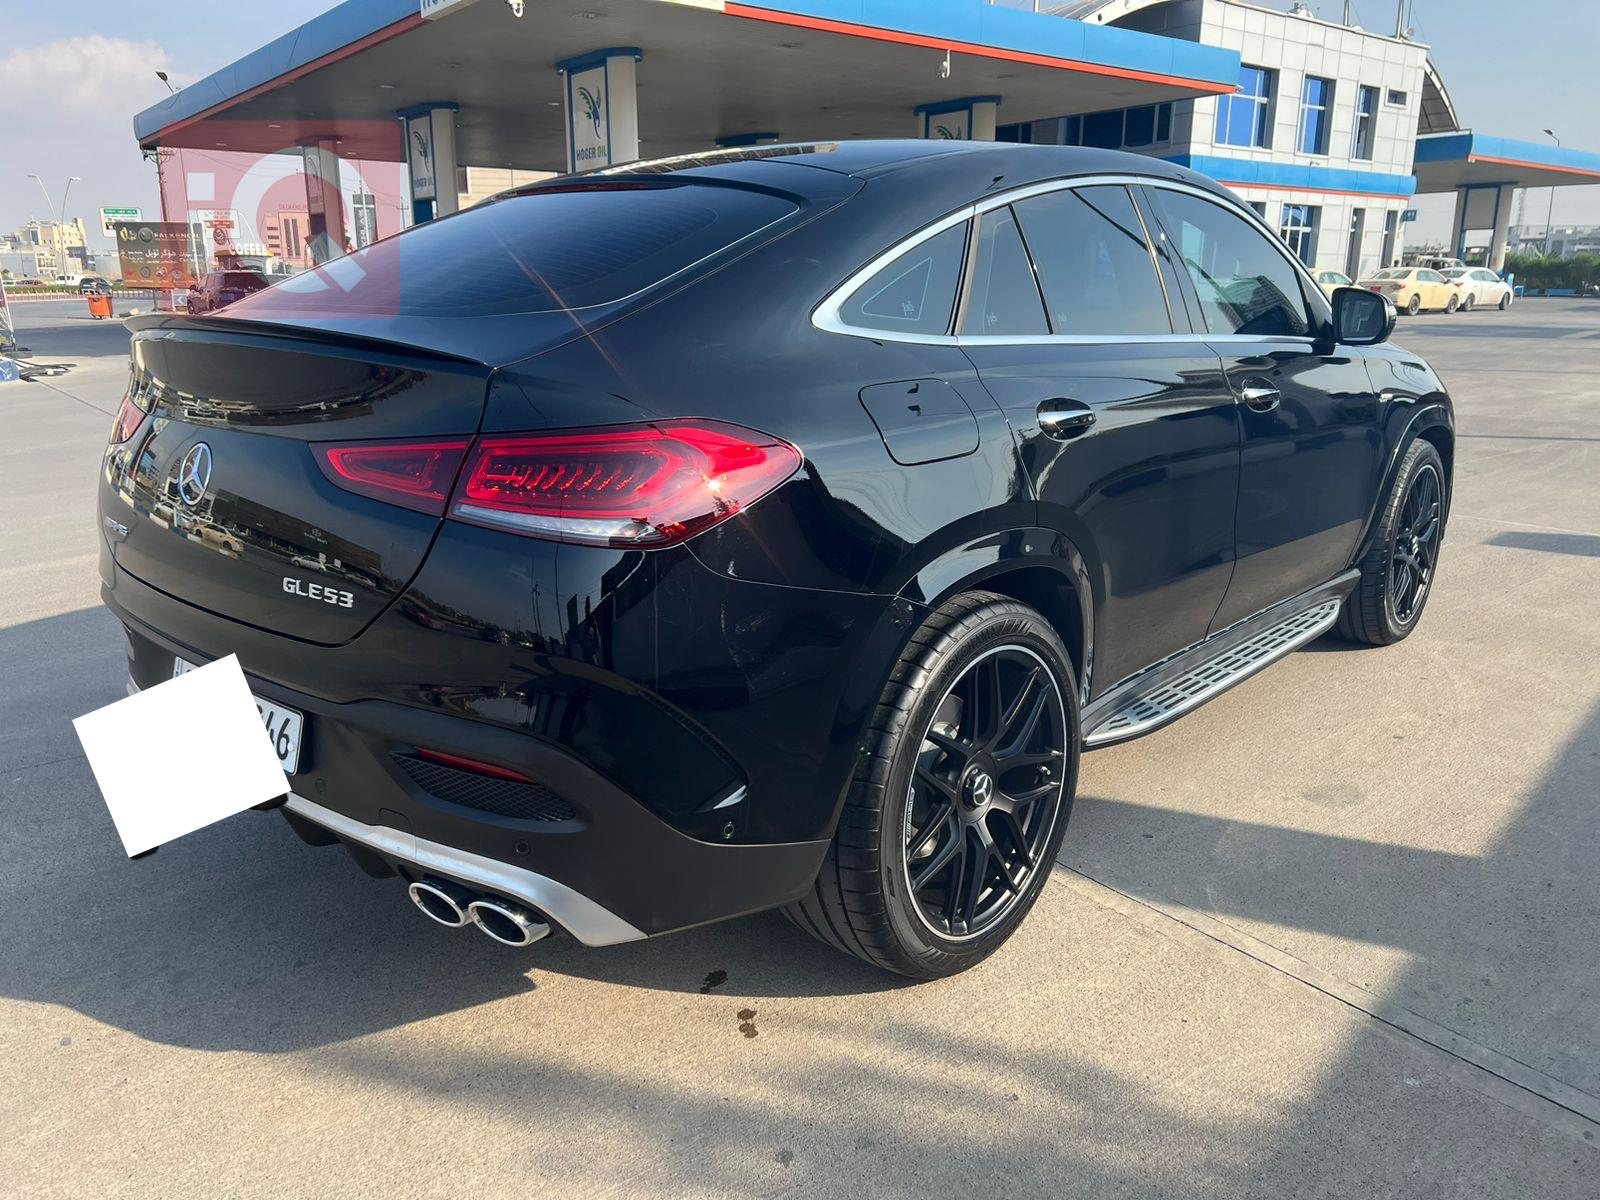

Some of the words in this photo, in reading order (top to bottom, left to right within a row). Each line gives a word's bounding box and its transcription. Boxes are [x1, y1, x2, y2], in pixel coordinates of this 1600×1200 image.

[576, 147, 597, 161] HOGER
[597, 145, 608, 158] OIL
[229, 243, 267, 256] COFFEE
[283, 577, 354, 608] GLE53
